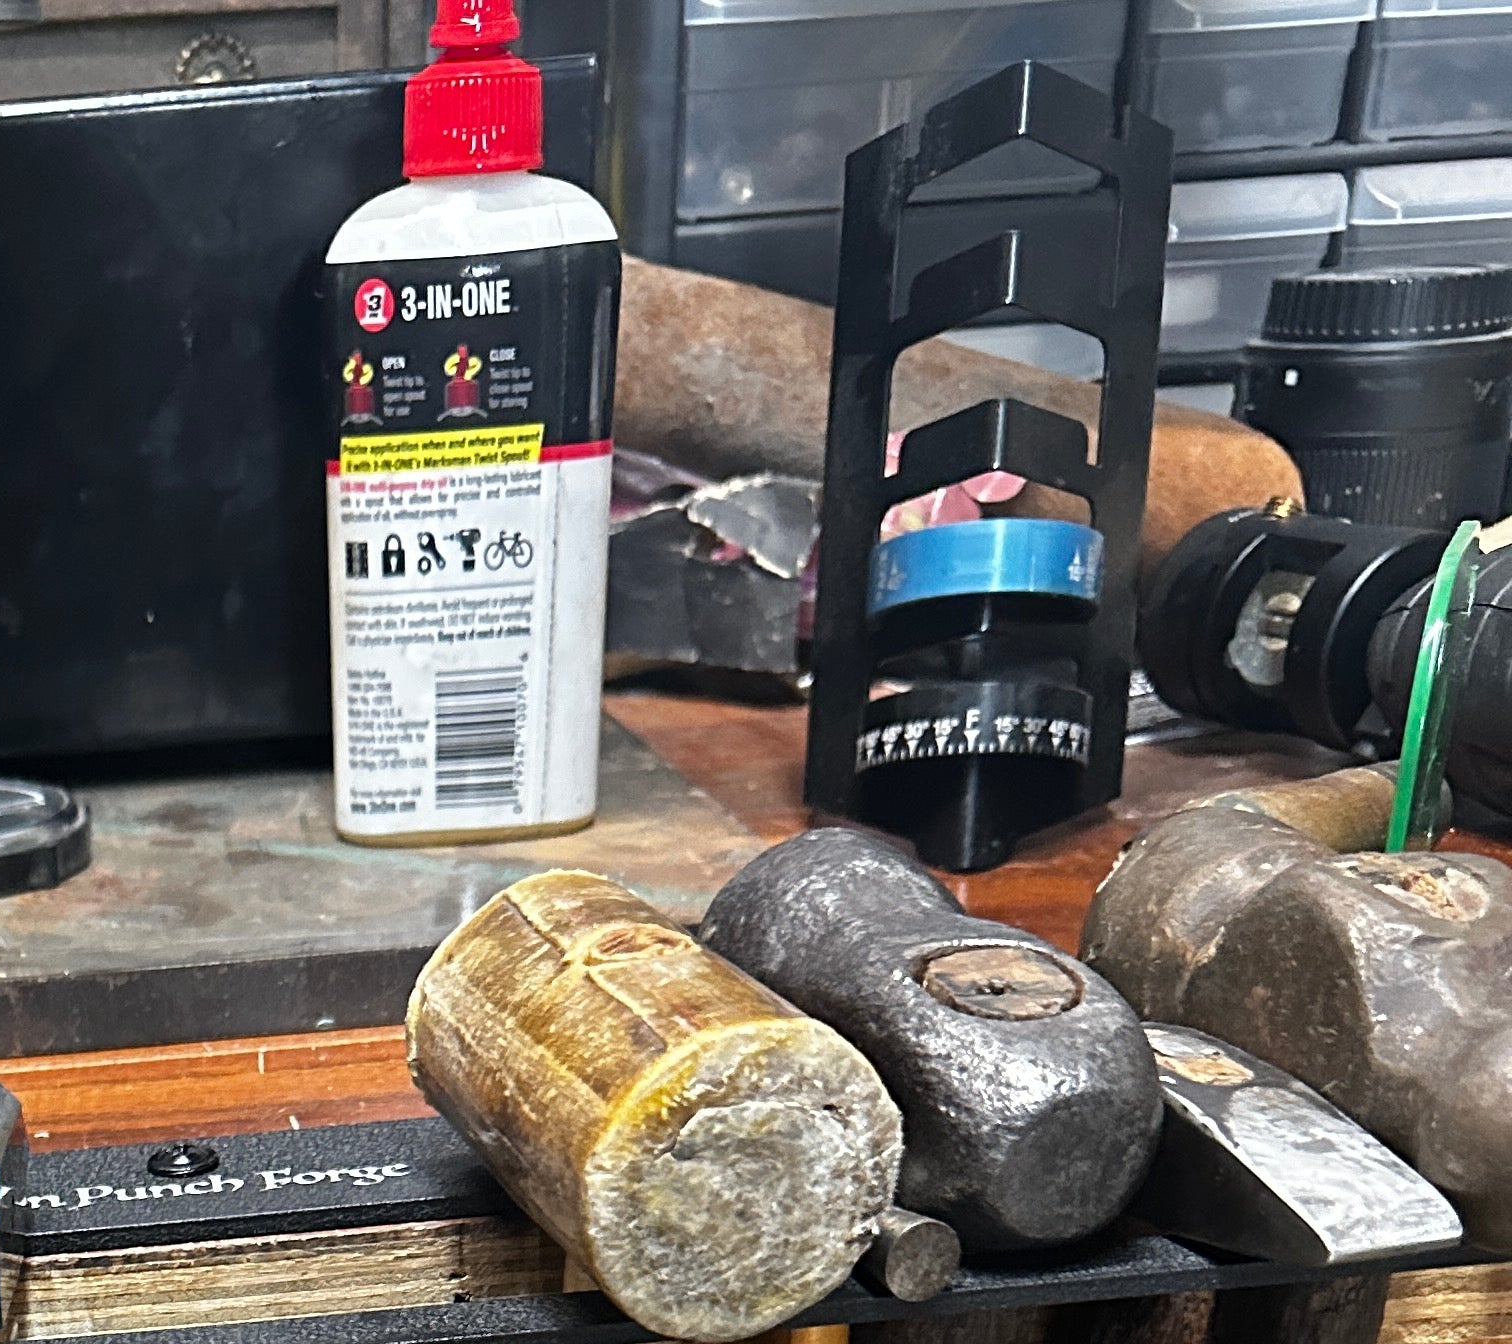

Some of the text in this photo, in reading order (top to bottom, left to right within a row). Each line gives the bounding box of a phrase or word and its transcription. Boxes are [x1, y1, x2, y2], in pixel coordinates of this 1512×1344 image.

[400, 278, 511, 322] 3-IN-ONE
[382, 356, 406, 370] OPEN
[489, 347, 516, 362] CLOSE
[370, 441, 419, 456] application
[421, 440, 446, 450] when
[449, 437, 466, 448] and
[468, 435, 496, 447] where
[498, 435, 514, 448] you
[517, 431, 540, 442] want
[965, 708, 981, 729] F
[67, 1173, 246, 1212] Punch
[255, 1162, 412, 1193] Forge
